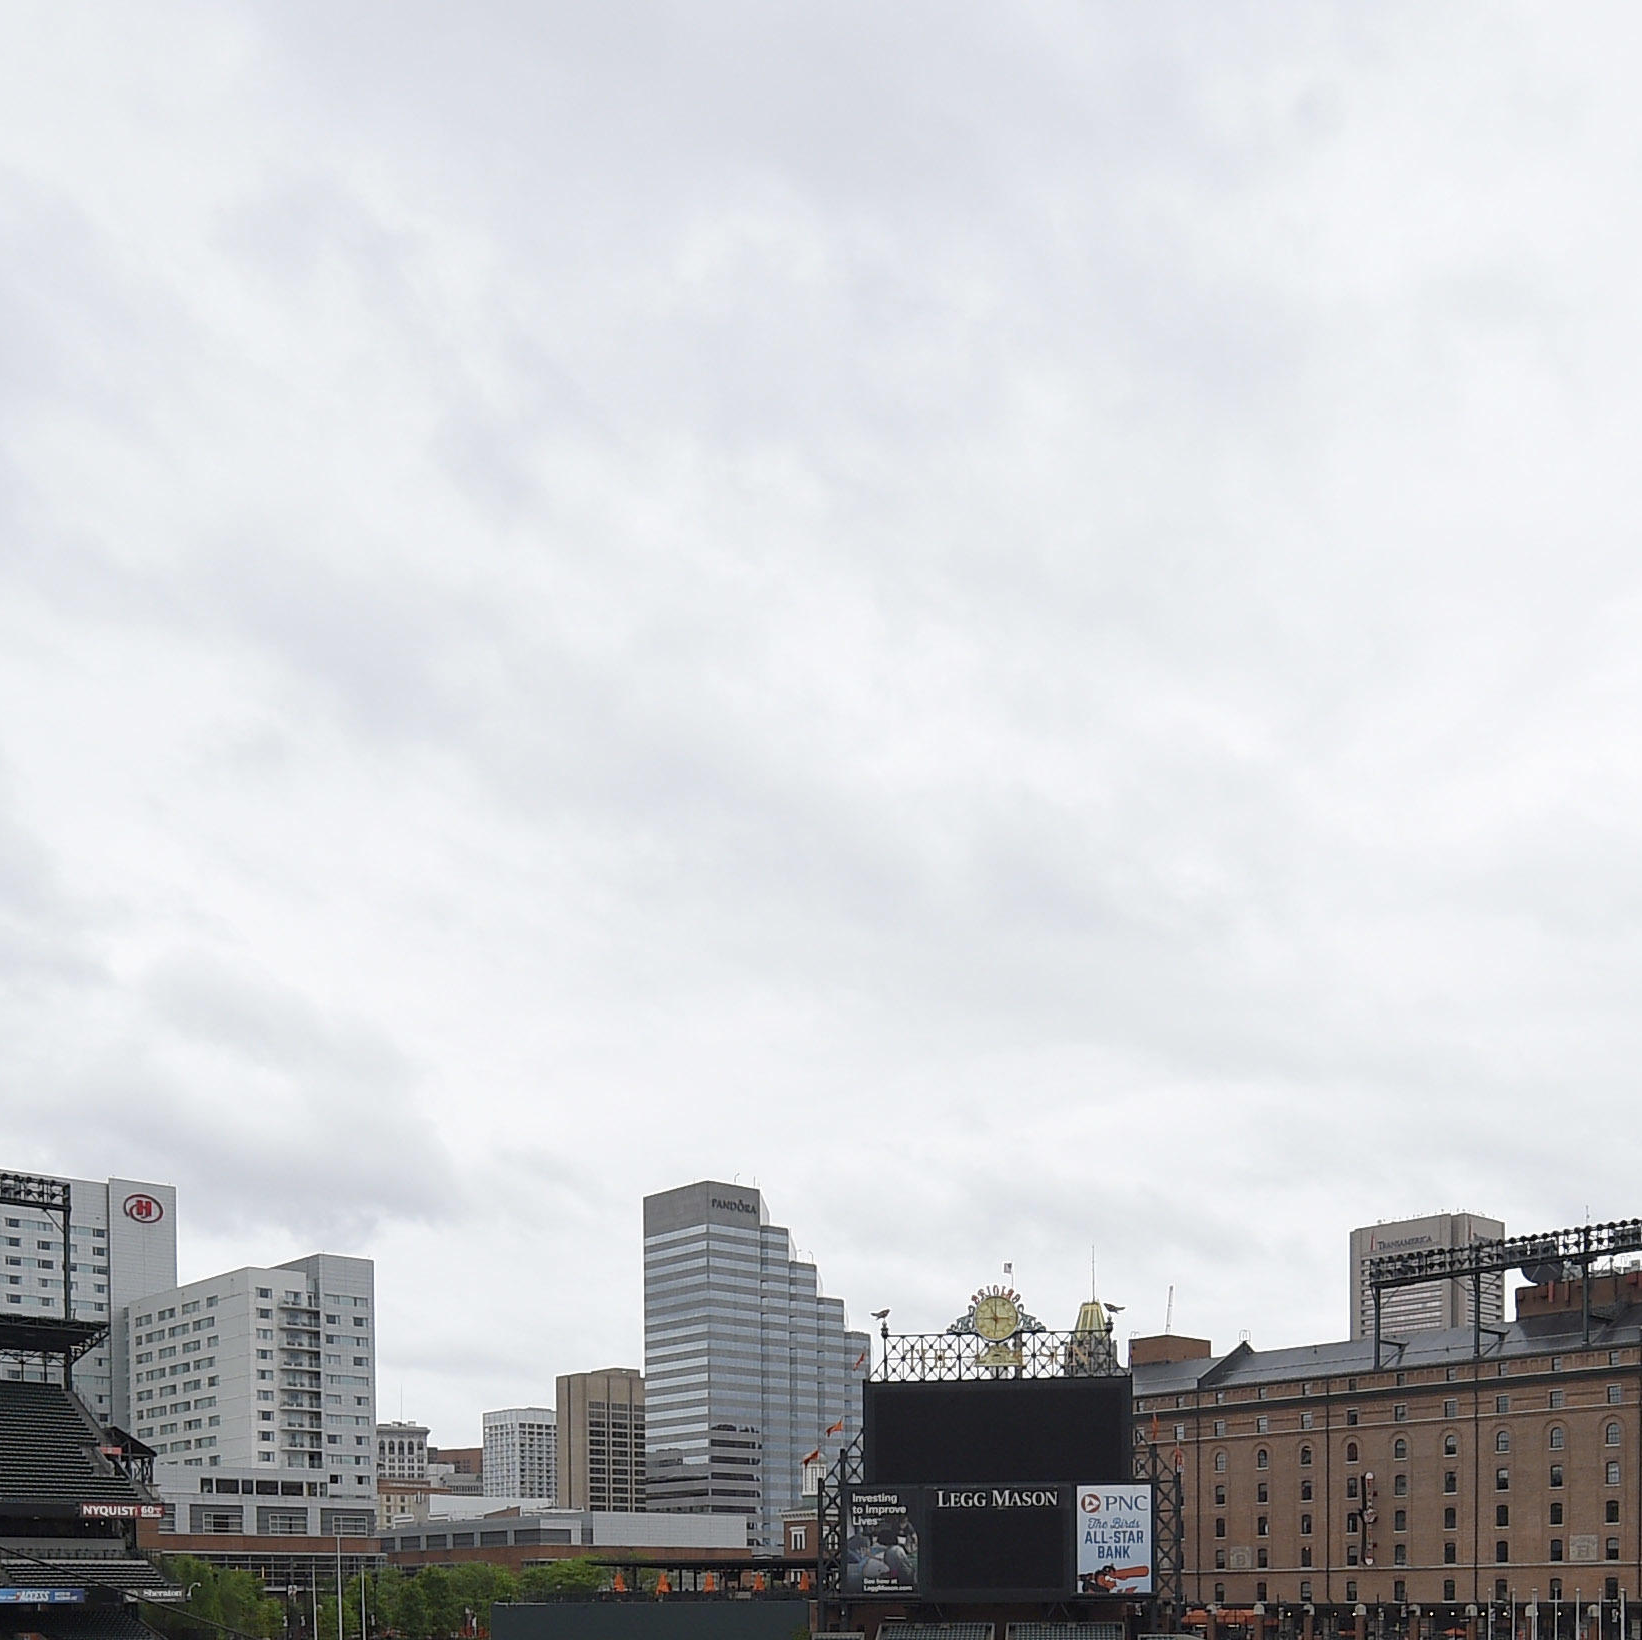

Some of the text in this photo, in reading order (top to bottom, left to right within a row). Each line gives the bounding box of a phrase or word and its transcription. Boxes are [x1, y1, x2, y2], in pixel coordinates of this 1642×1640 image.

[1377, 1235, 1432, 1251] TRANSAMERICA
[852, 1493, 898, 1504] Investing
[936, 1489, 1058, 1508] LEGG MASON
[1103, 1495, 1148, 1512] PNC
[83, 1505, 135, 1517] NYQUIST
[852, 1505, 907, 1516] to Improve
[1087, 1517, 1141, 1529] The Birds
[1084, 1530, 1144, 1544] ALL-STAR
[1097, 1545, 1130, 1559] BANK
[143, 1589, 183, 1598] Sheraton
